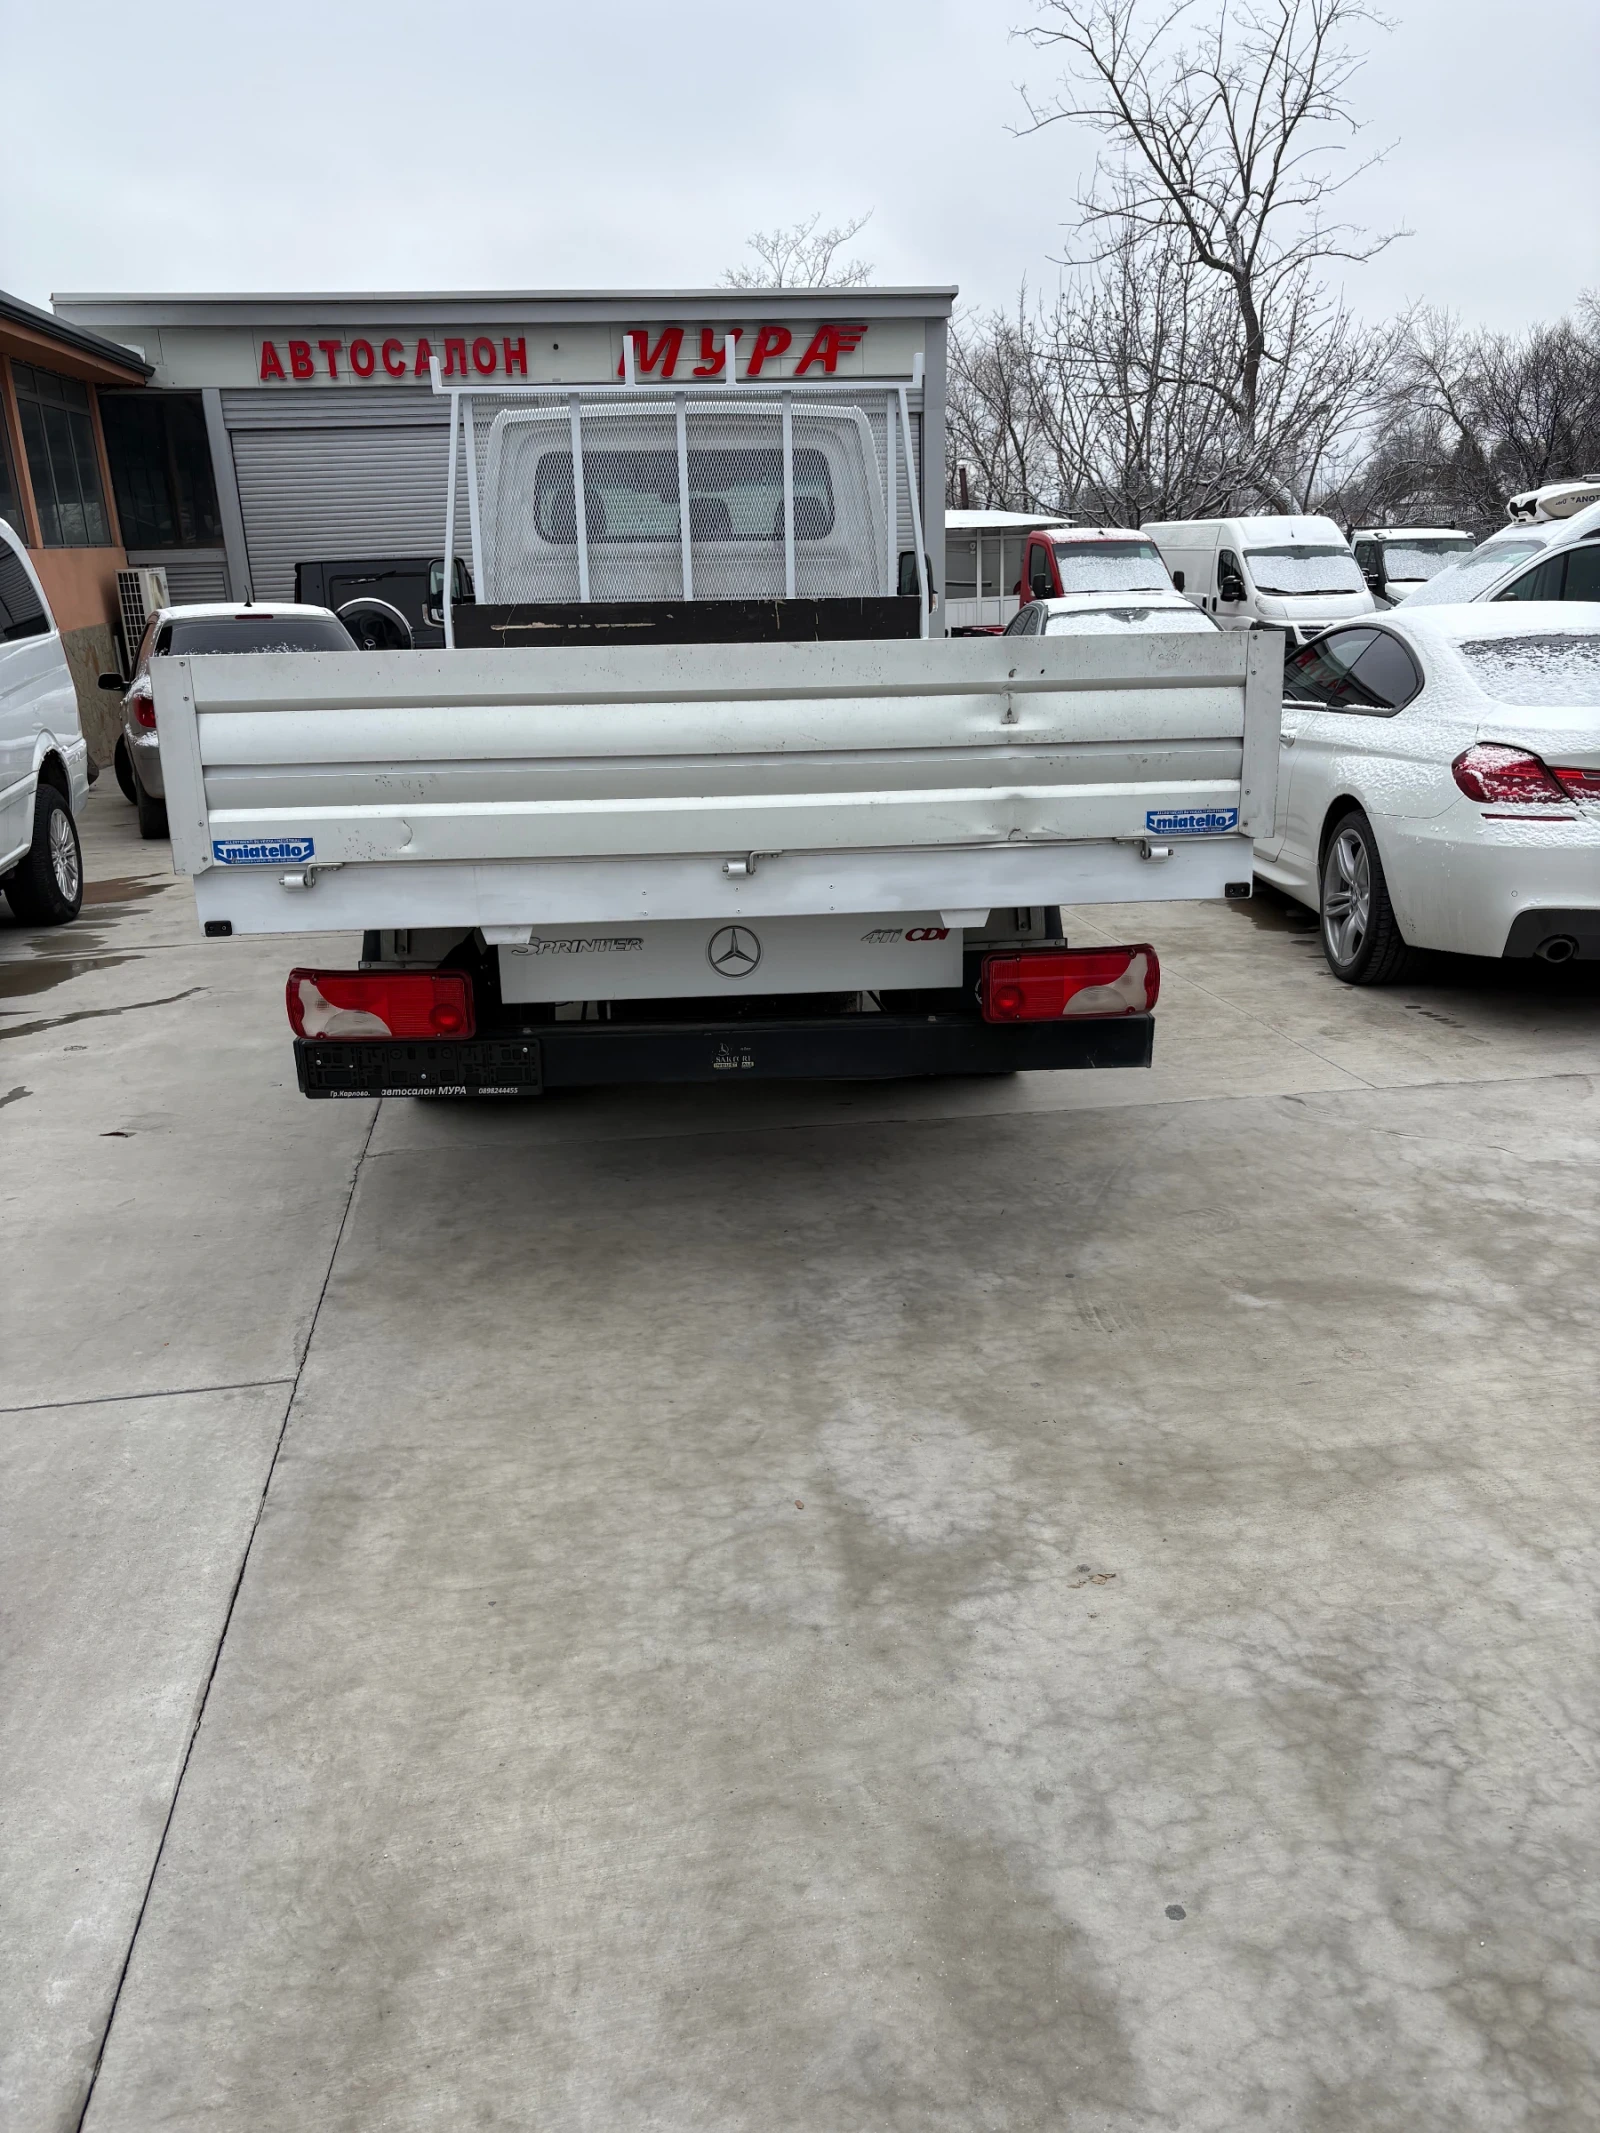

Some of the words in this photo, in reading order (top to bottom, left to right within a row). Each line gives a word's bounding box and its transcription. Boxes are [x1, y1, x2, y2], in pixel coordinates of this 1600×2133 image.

[260, 337, 527, 379] АВТОСАЛОН
[617, 325, 868, 379] МУРА
[1156, 814, 1226, 828] miatello
[226, 844, 302, 858] miatello
[904, 927, 950, 942] CDI
[511, 937, 643, 955] SPRINTER
[381, 1087, 436, 1096] автосалон
[438, 1086, 467, 1095] МУРА
